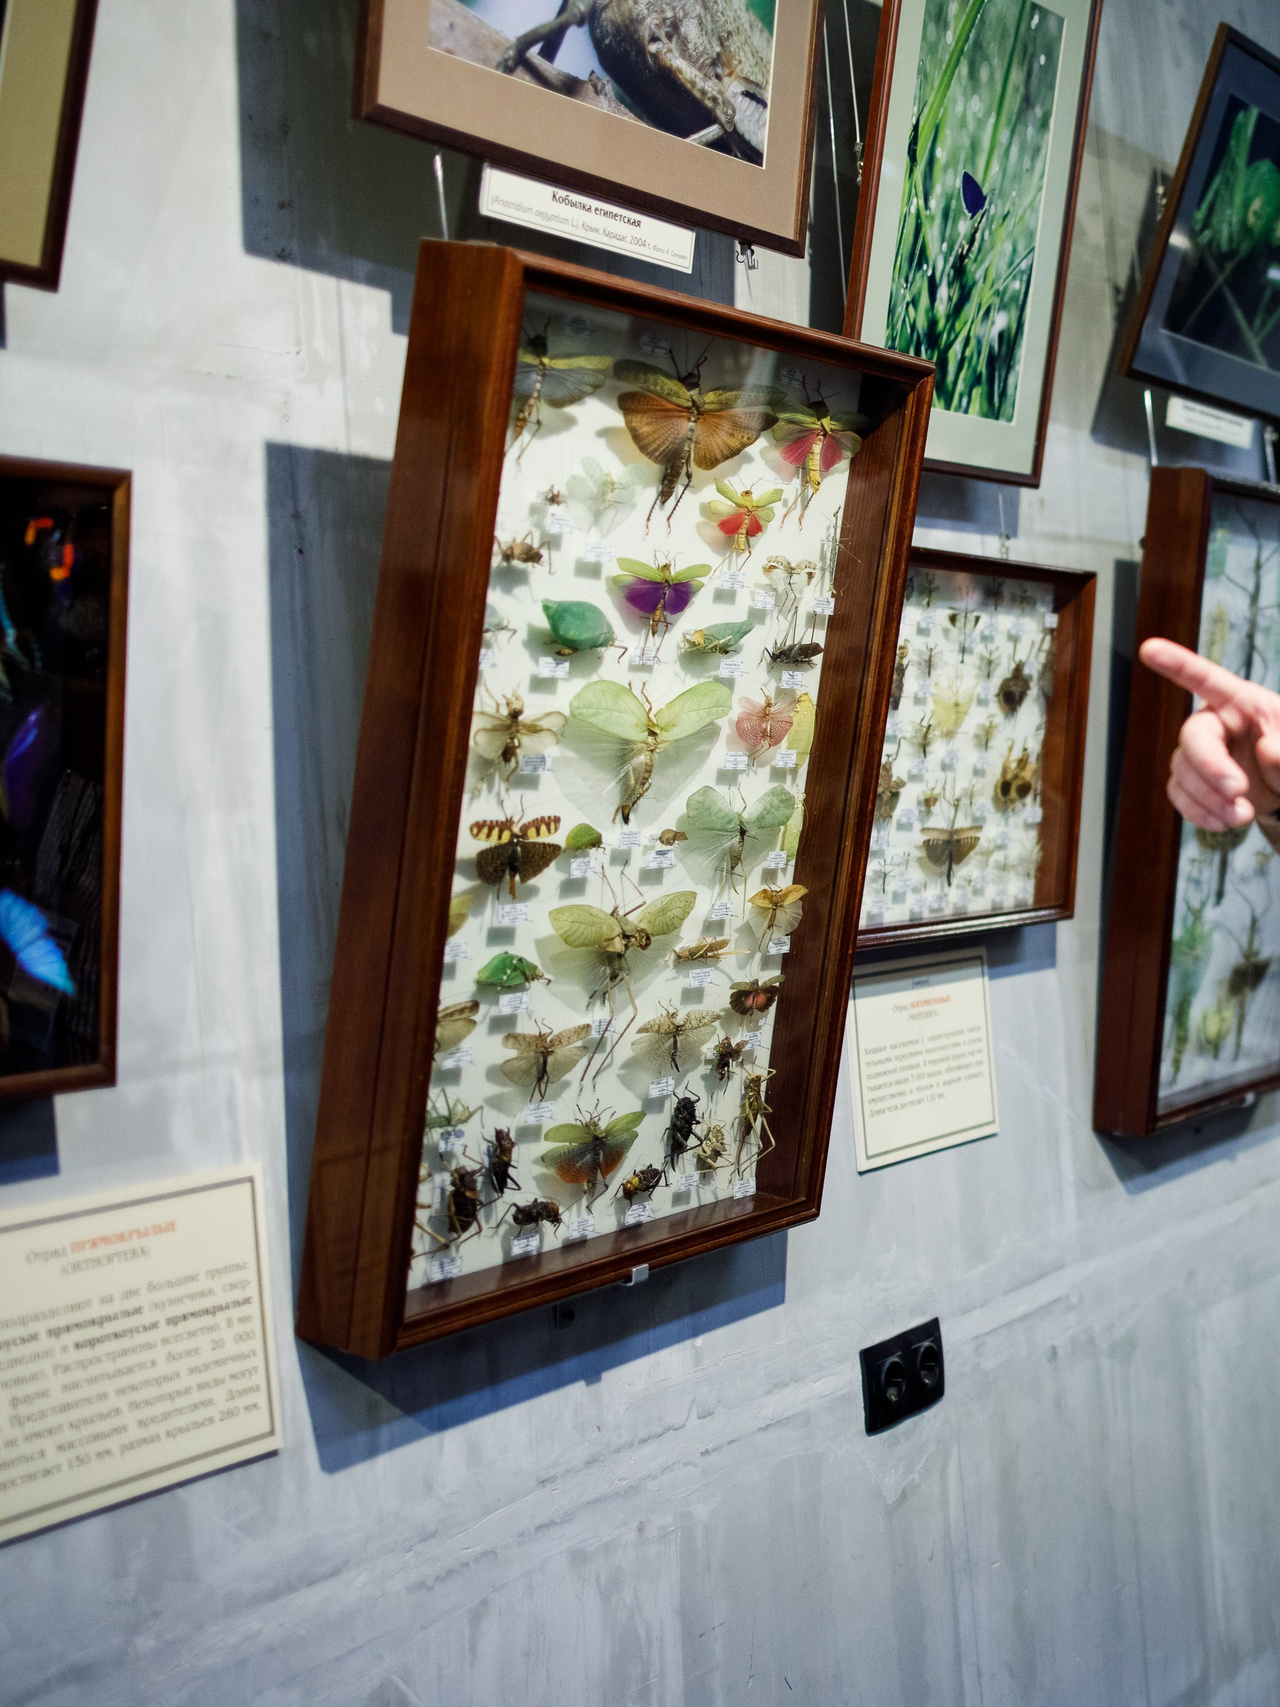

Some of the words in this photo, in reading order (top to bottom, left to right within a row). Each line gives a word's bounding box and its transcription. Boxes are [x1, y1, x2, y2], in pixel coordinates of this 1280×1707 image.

[552, 190, 592, 213] Кобылка
[594, 206, 641, 228] египетская
[535, 209, 570, 225] aegyptium
[630, 235, 647, 248] 2004
[147, 1273, 199, 1294] большие
[47, 1305, 144, 1339] прямокрылые
[74, 1321, 159, 1350] короткоусые
[166, 1296, 253, 1327] прямокрылые
[167, 1346, 201, 1363] более
[211, 1337, 225, 1351] 20
[234, 1329, 256, 1344] 000
[226, 1384, 261, 1402] Длина
